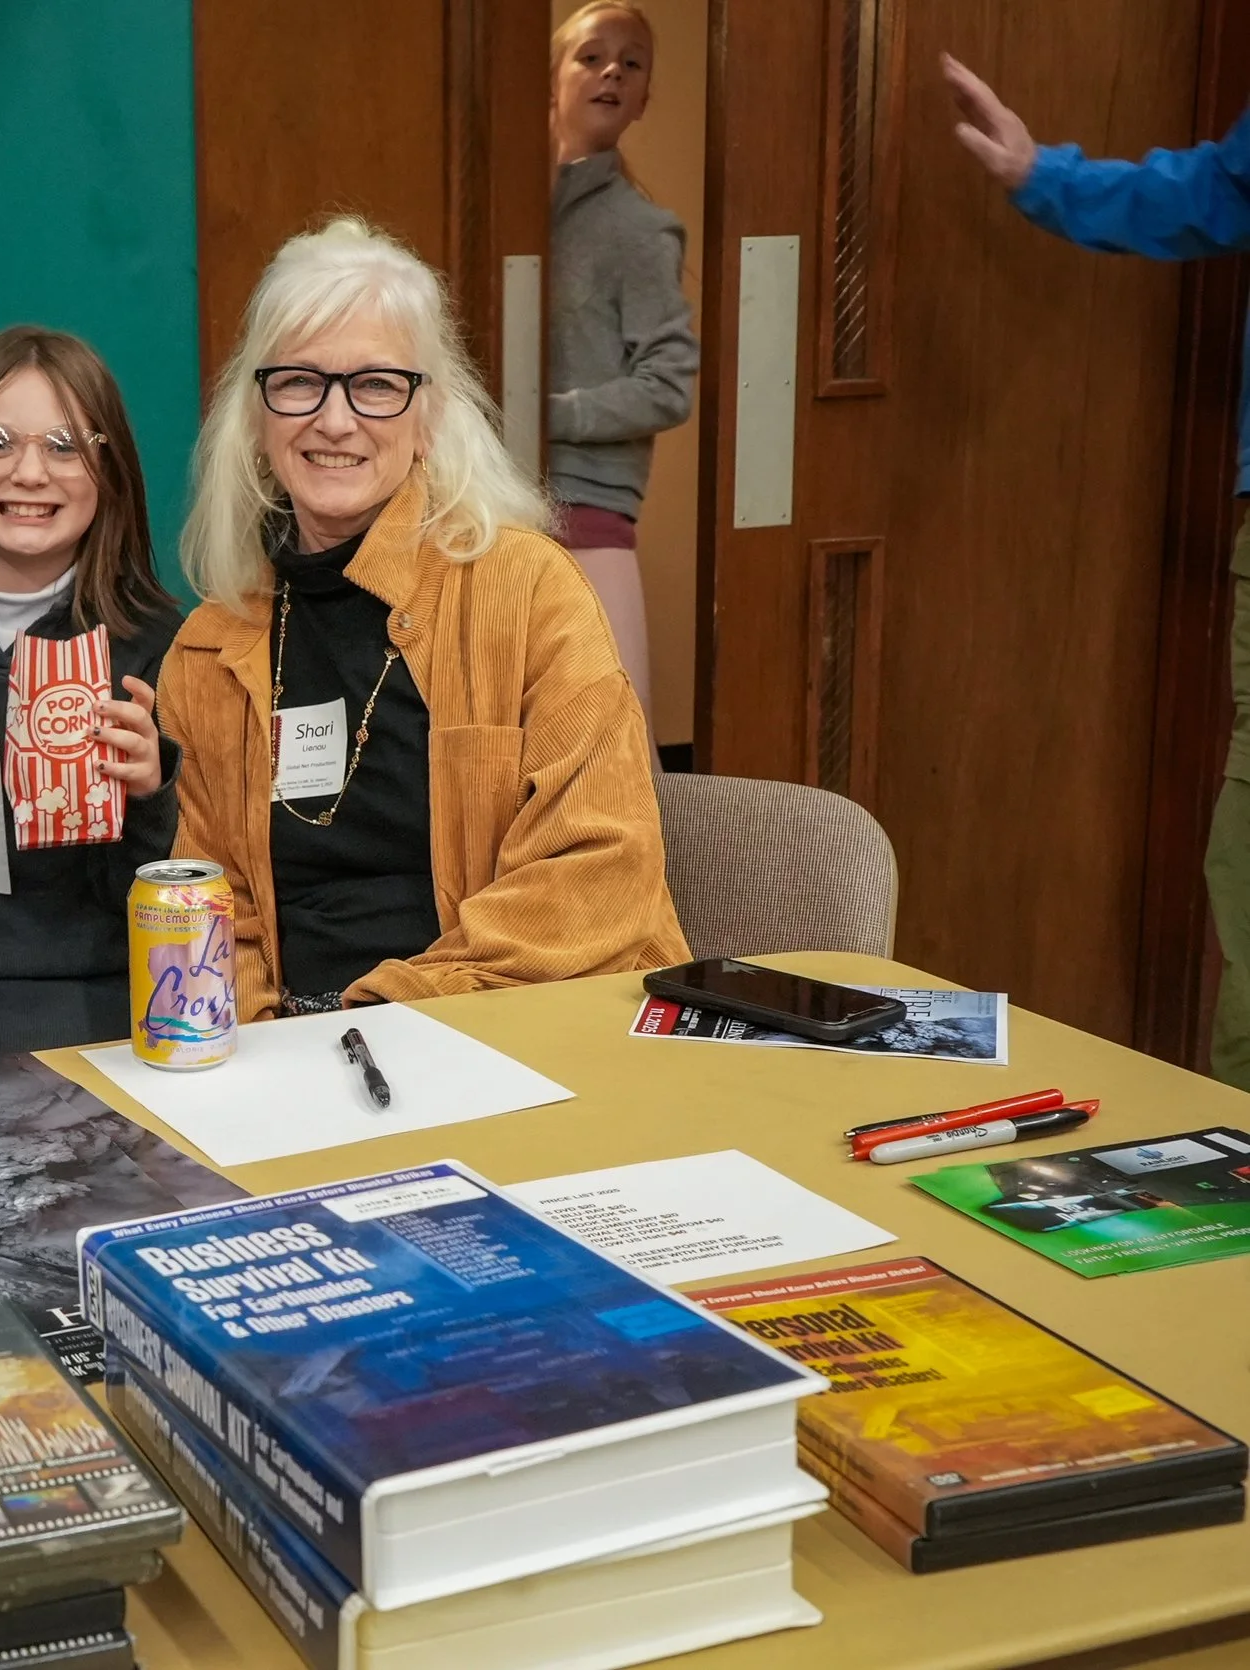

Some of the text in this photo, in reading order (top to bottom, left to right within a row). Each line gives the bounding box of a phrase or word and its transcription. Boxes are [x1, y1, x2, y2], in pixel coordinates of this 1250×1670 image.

[46, 696, 85, 714] POP
[37, 711, 91, 734] CORN
[295, 720, 334, 740] Shari
[134, 910, 214, 924] PAMPLEMOUSSE
[189, 914, 231, 978] La
[111, 1168, 436, 1239] What Every Business Should Know Before Disaster Strikes
[539, 1196, 571, 1204] PRICE
[553, 1206, 577, 1214] DVD
[568, 1220, 599, 1229] BOOK
[577, 1215, 658, 1234] DOCUMENTARY
[586, 1211, 616, 1220] BOOK
[634, 1220, 658, 1229] DVD
[619, 1231, 637, 1239] KIT
[626, 1236, 642, 1244] US
[1171, 1234, 1223, 1248] VIRTUAL
[135, 1222, 333, 1277] Business
[629, 1247, 672, 1259] HELENS
[674, 1239, 718, 1251] POSTER
[719, 1234, 748, 1243] FREE
[637, 1235, 783, 1264] FREE WITH ANY PURCHASE
[642, 1261, 671, 1270] make
[681, 1251, 727, 1263] donation
[760, 1242, 785, 1250] kind
[1062, 1242, 1113, 1258] LOOKING
[172, 1256, 324, 1304] Survival
[312, 1246, 378, 1276] Kit
[752, 1286, 788, 1299] Should
[786, 1282, 815, 1294] Know
[814, 1277, 849, 1290] Before
[848, 1271, 889, 1285] Disaster
[201, 1277, 374, 1321] For Earthquakes
[222, 1290, 415, 1339] & Other Disasters
[859, 1330, 907, 1353] Kit
